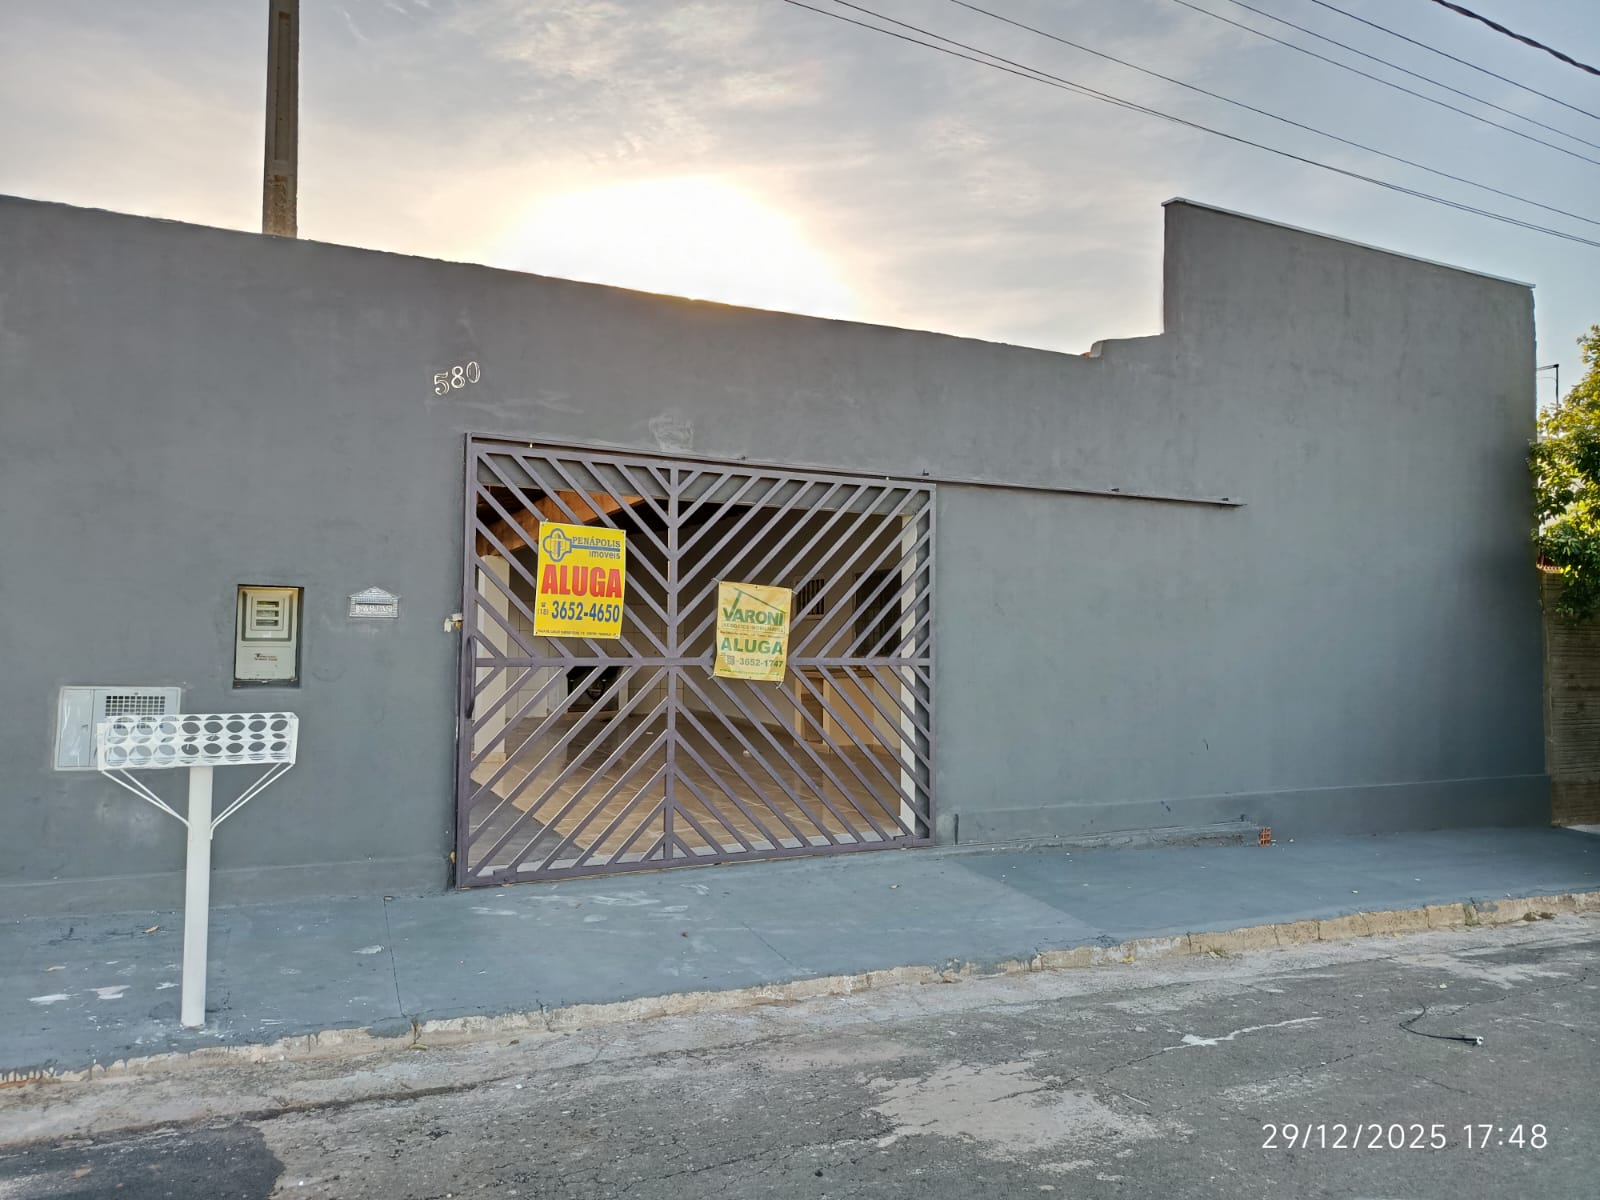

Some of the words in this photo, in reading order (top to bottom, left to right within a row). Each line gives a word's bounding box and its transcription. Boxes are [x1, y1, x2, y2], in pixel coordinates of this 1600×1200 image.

[434, 361, 481, 396] 580
[572, 536, 621, 548] PENÁPOLIS
[541, 564, 622, 598] ALUGA
[552, 600, 620, 623] 3652-4650
[723, 597, 784, 626] VARONI
[720, 637, 784, 655] ALUGA
